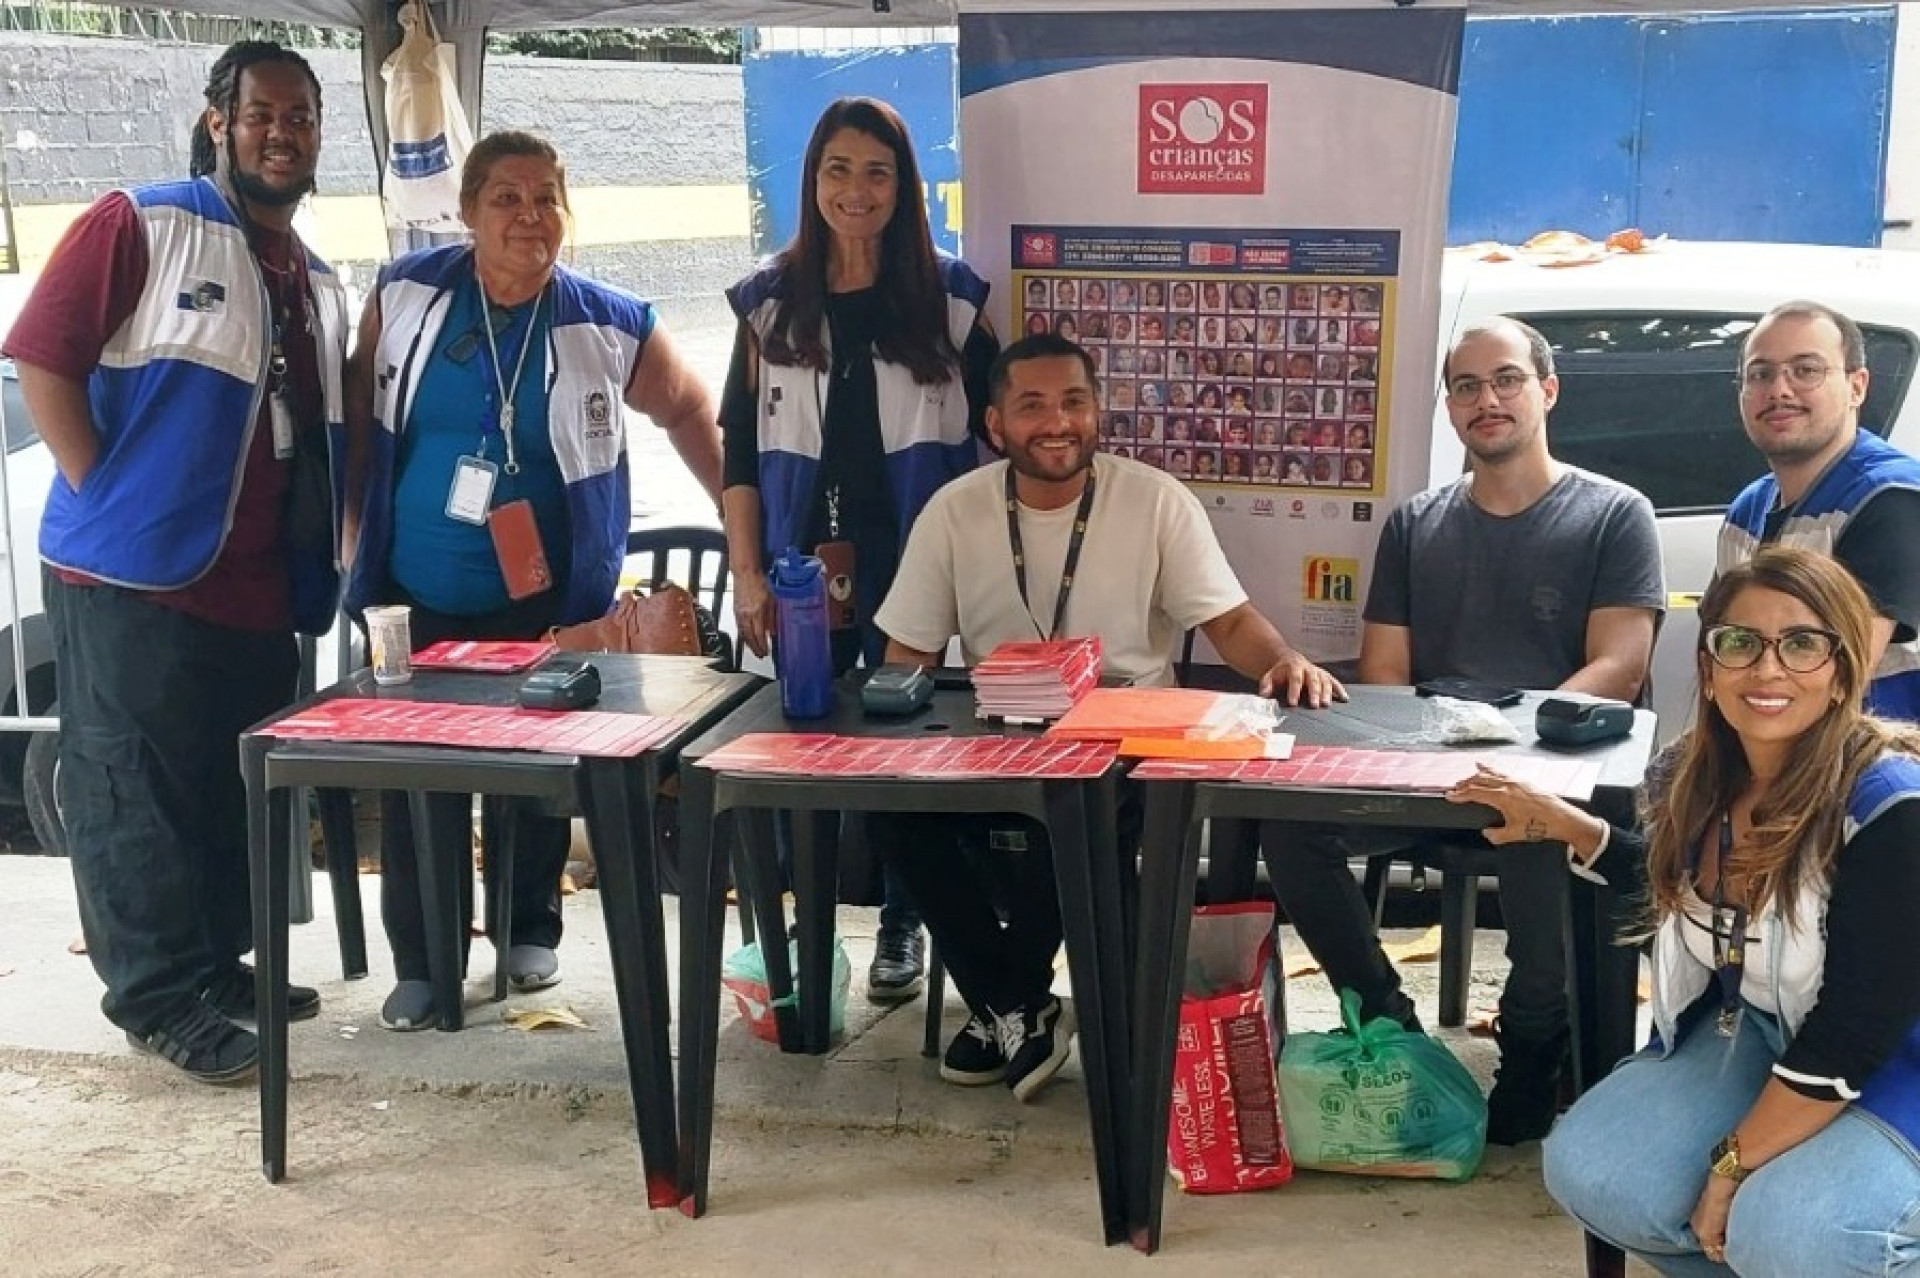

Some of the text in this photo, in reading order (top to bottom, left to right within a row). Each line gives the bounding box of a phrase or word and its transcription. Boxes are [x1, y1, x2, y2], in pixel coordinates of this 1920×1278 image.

[1149, 97, 1255, 143] SOS
[1149, 141, 1254, 173] crianças
[1307, 559, 1352, 601] fia
